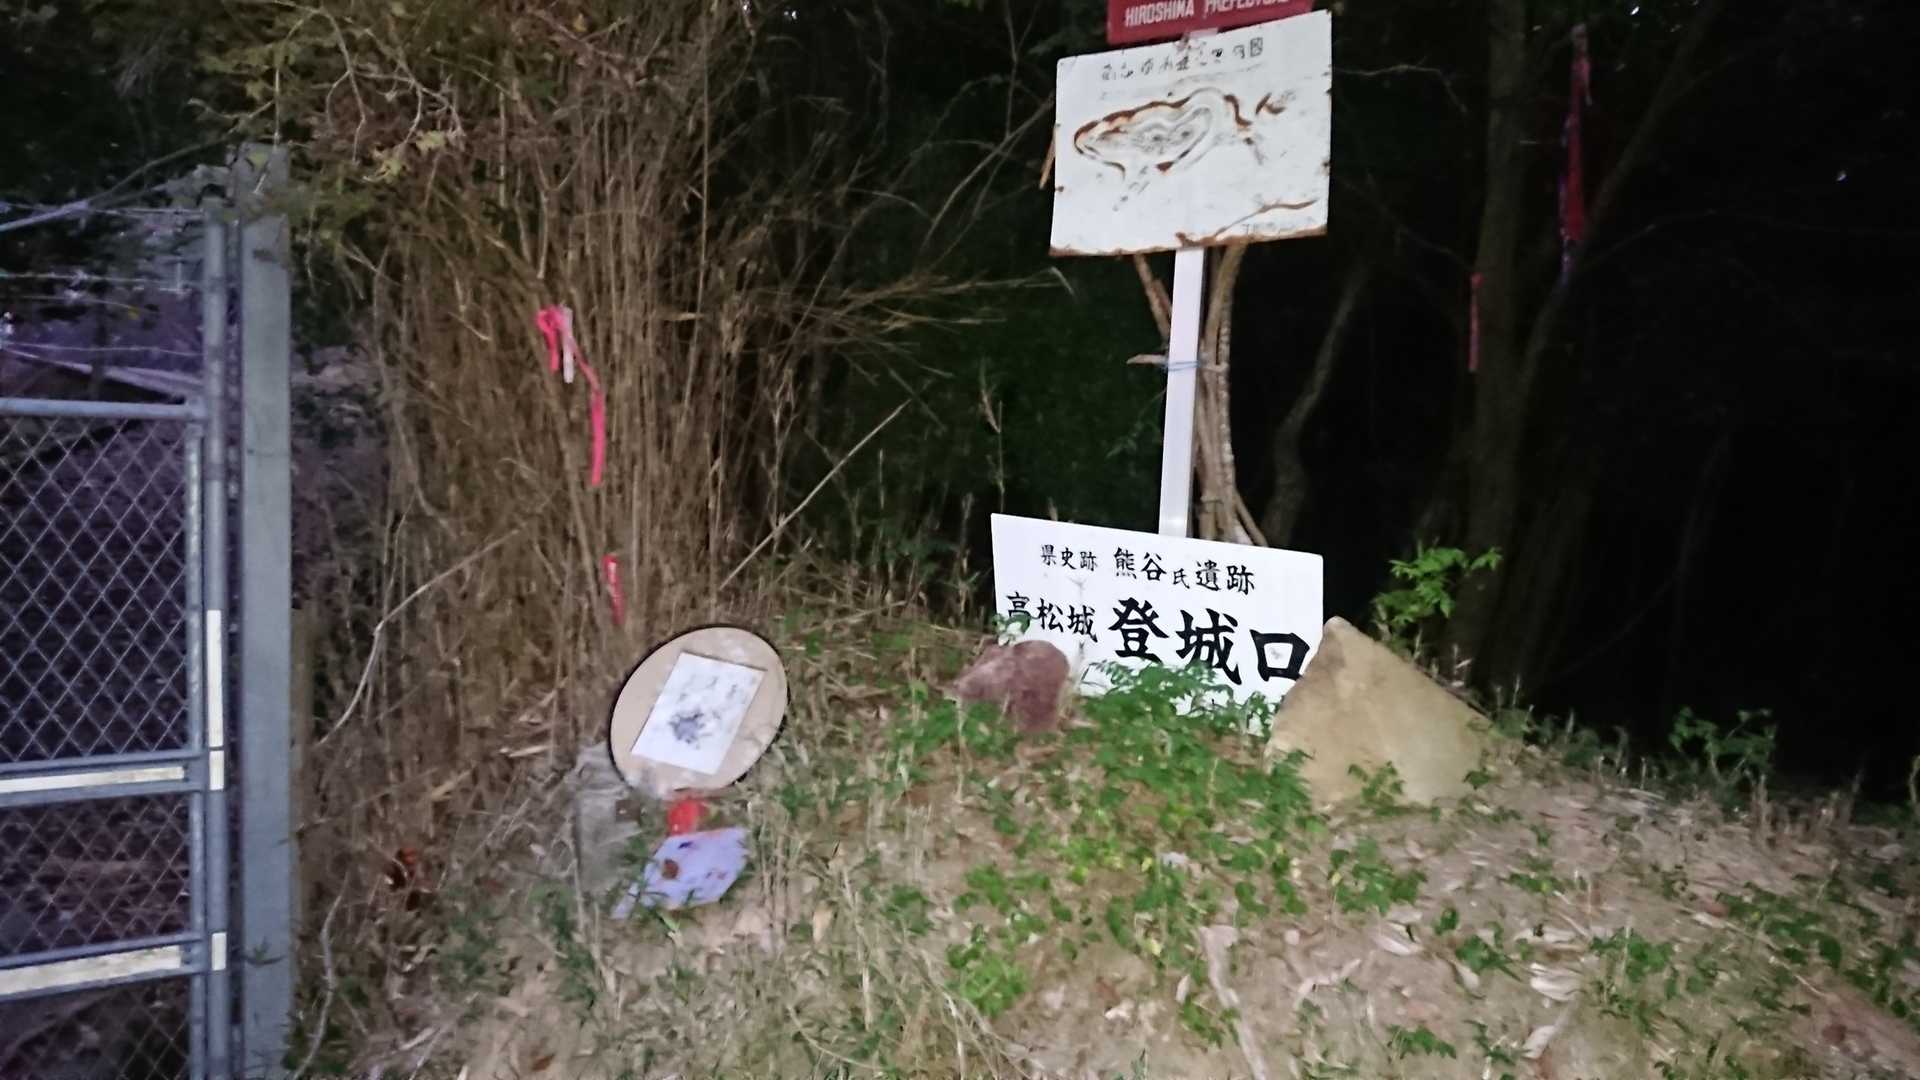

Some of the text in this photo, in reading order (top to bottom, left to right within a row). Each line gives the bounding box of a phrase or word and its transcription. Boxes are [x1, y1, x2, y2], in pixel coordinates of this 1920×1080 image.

[1124, 0, 1195, 27] HIROSHIMA
[1041, 544, 1255, 595] 県史跡 熊谷氏遺跡
[1006, 591, 1310, 685] 高松城 登城口
